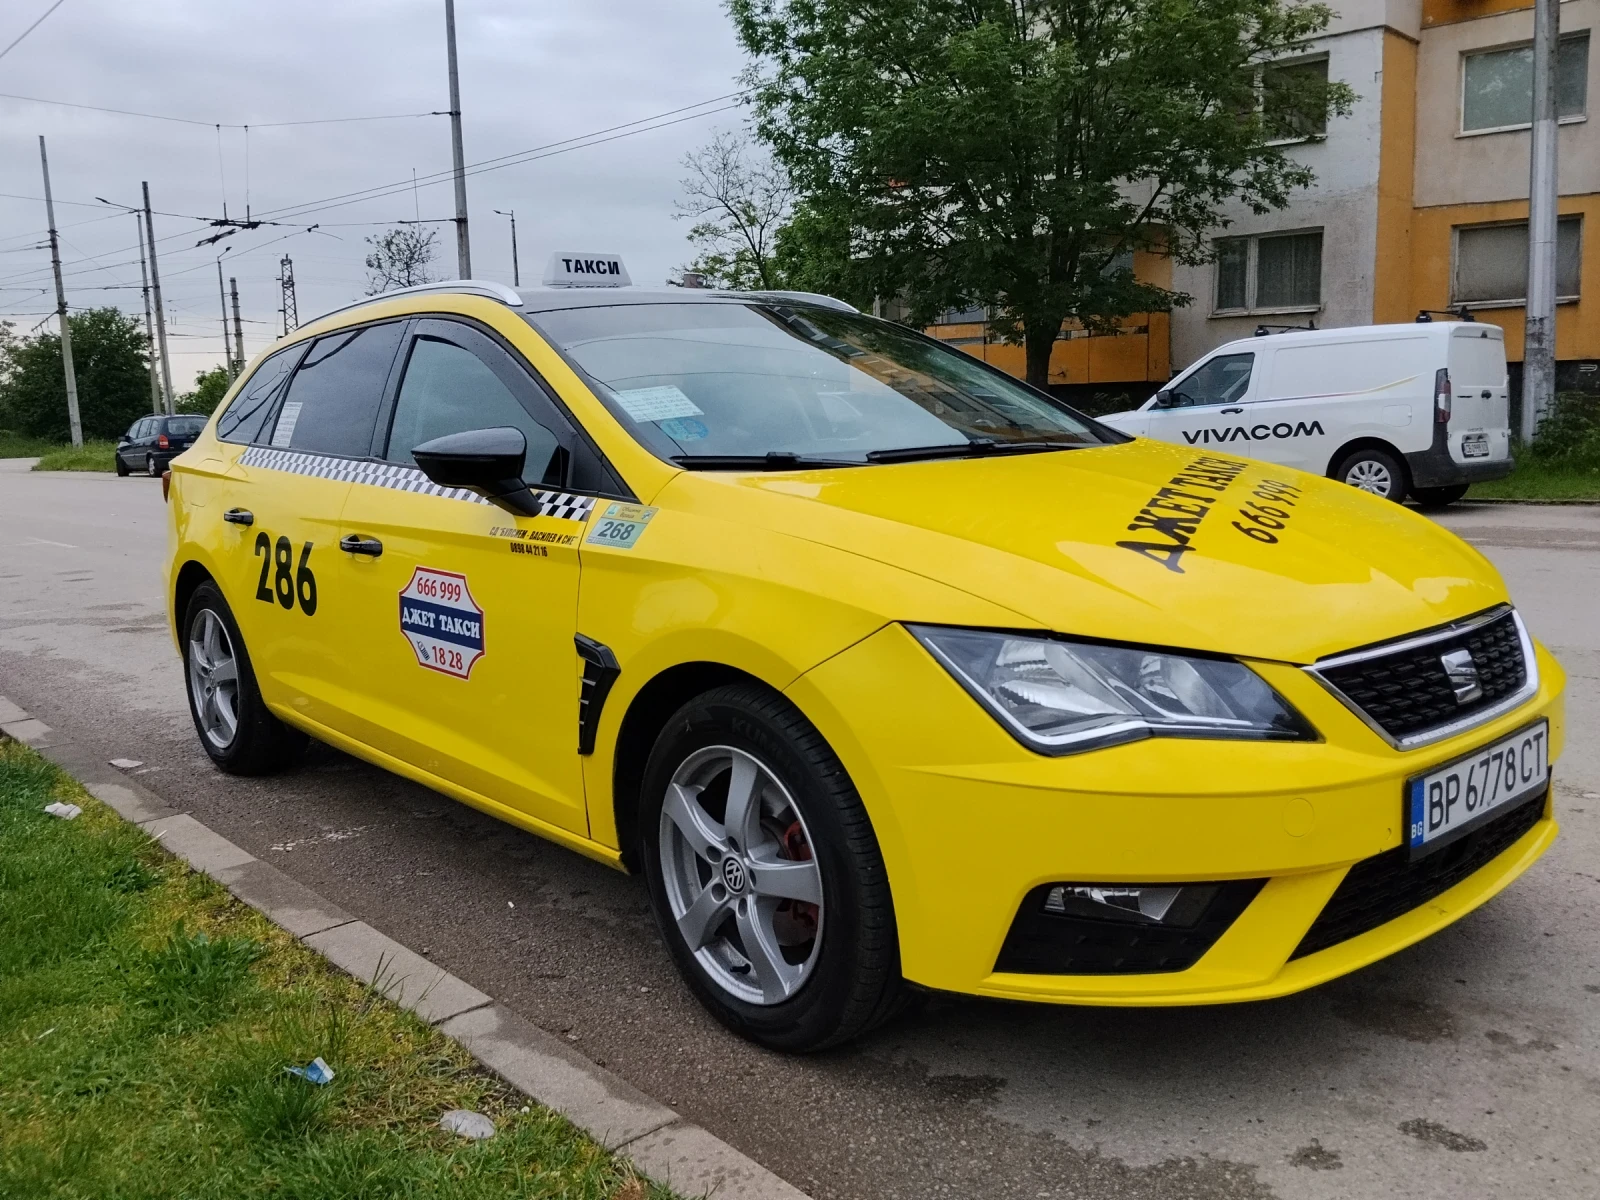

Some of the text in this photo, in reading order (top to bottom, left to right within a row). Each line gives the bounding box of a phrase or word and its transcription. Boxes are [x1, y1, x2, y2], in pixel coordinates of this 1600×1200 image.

[562, 258, 620, 275] ТАКСИ
[1182, 420, 1325, 444] VIVACOM
[1115, 456, 1249, 573] ДЖЕТ ТАКСИ
[1231, 479, 1302, 544] 666 999
[597, 521, 635, 540] 268
[255, 531, 317, 617] 286
[417, 577, 461, 602] 666 999
[402, 606, 480, 639] ДЖЕТ ТАКСИ
[432, 645, 463, 670] 18 28
[1428, 732, 1544, 832] BP 6778 CT
[1411, 821, 1423, 838] BG
